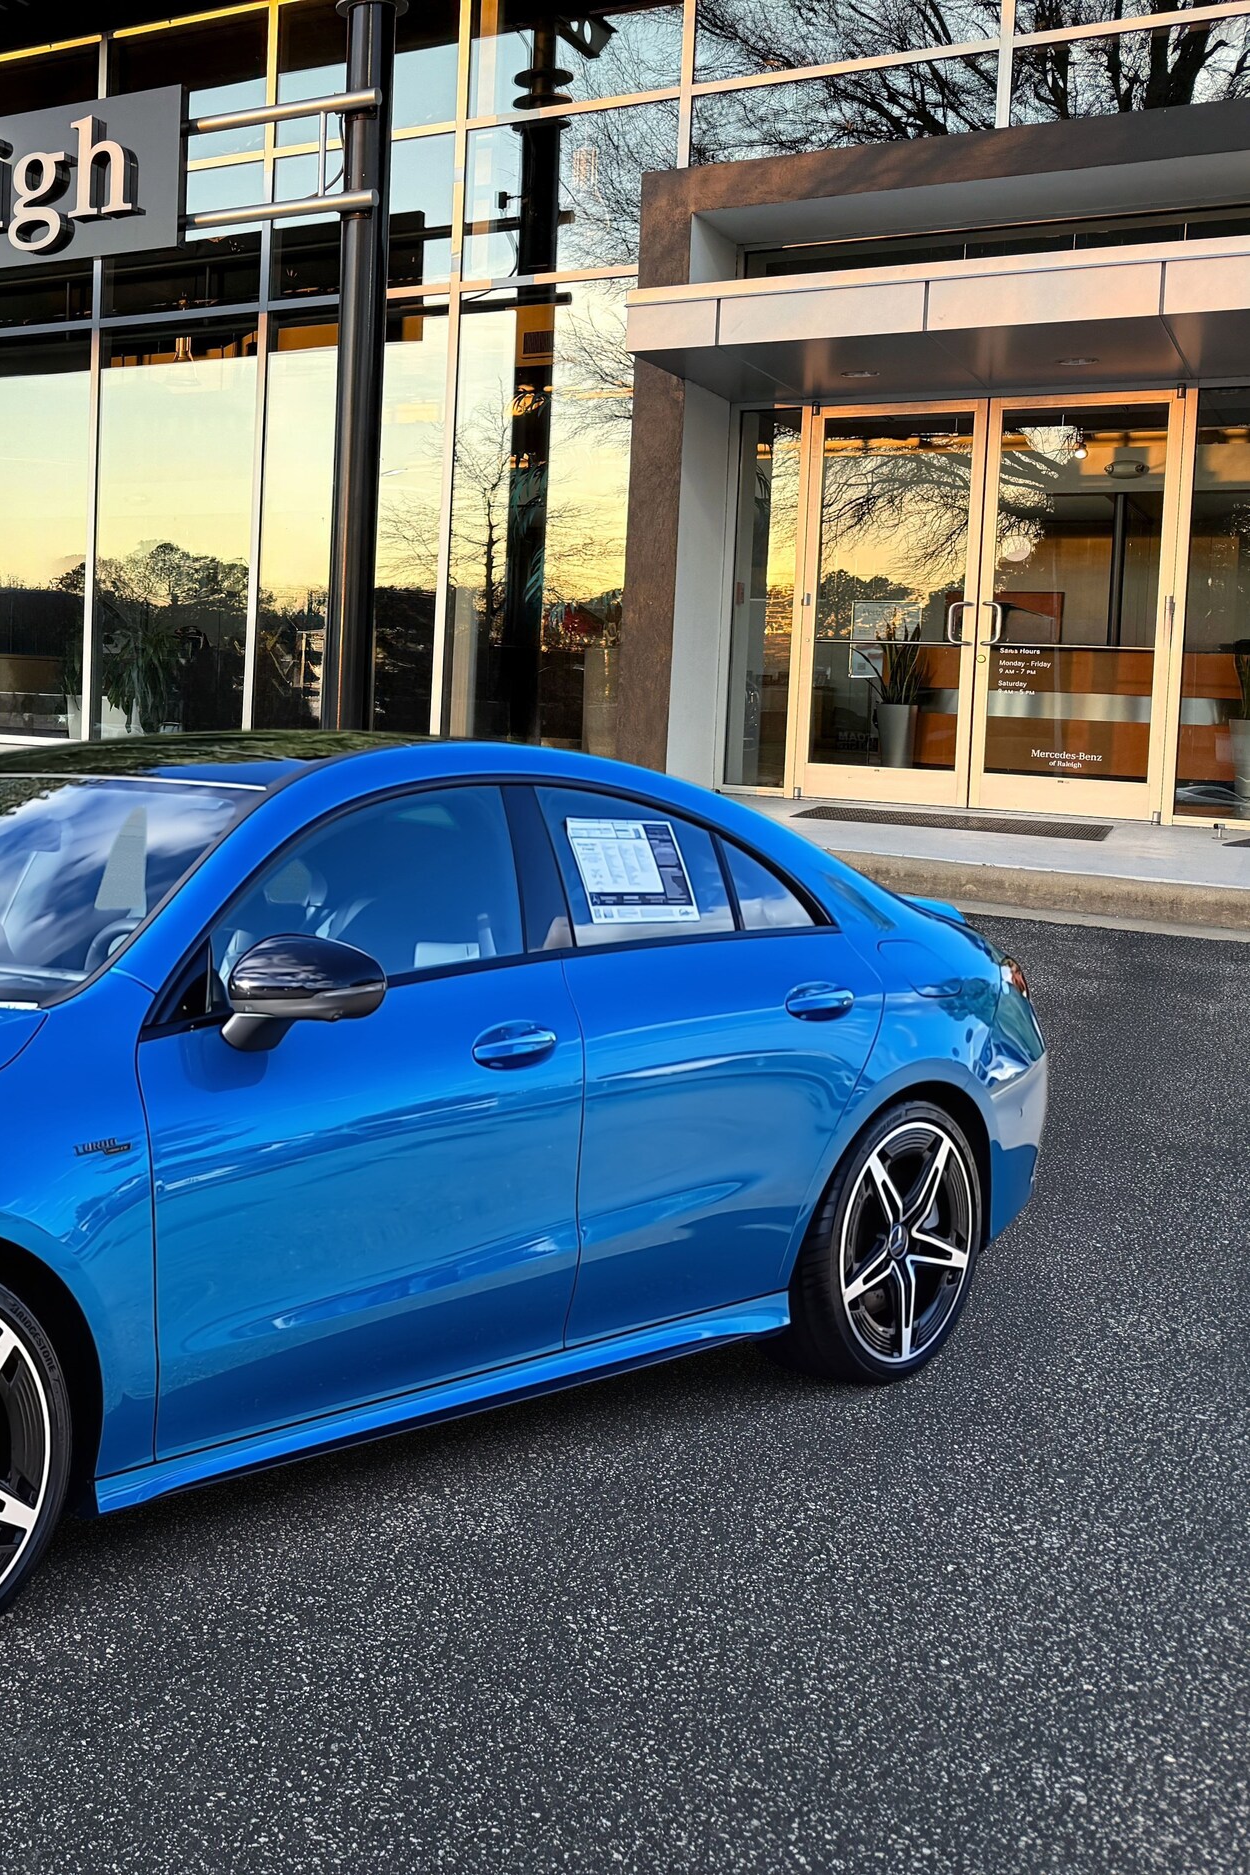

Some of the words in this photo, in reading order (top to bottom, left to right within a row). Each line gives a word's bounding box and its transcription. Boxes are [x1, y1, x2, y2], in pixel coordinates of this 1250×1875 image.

[1019, 647, 1041, 655] Hours
[997, 680, 1028, 689] Saturday
[1030, 749, 1103, 762] Mercedes-Benz
[1057, 761, 1082, 769] Raleigh
[8, 1299, 56, 1374] BRIDGESTONE
